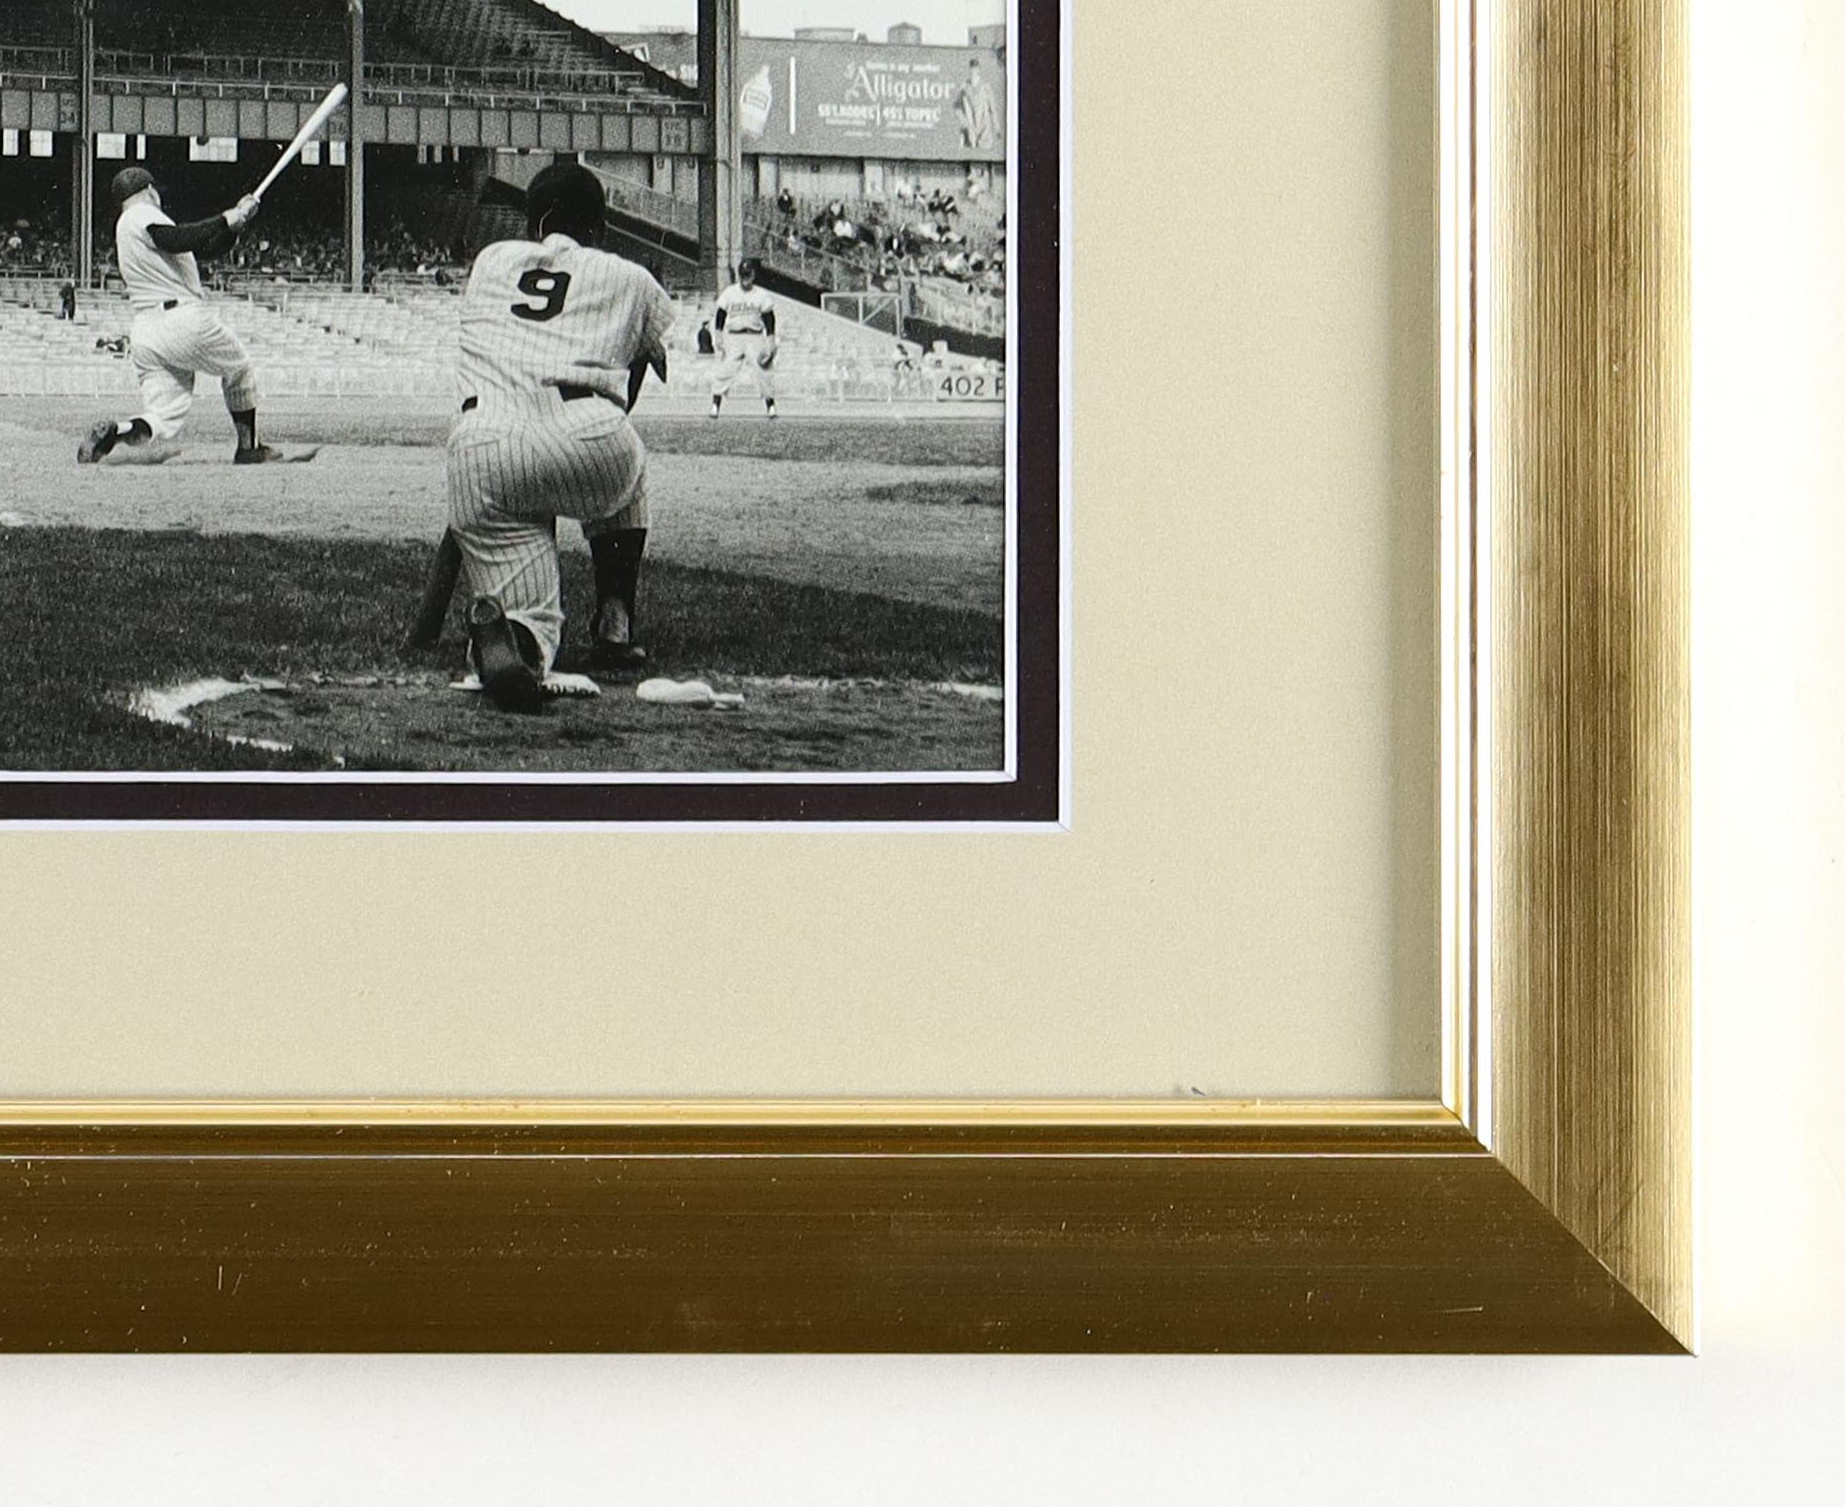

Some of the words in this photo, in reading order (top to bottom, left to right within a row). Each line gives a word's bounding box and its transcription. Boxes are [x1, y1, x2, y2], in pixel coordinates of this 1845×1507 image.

[844, 65, 955, 103] Alligator
[510, 268, 572, 322] 9
[940, 376, 985, 396] 402
